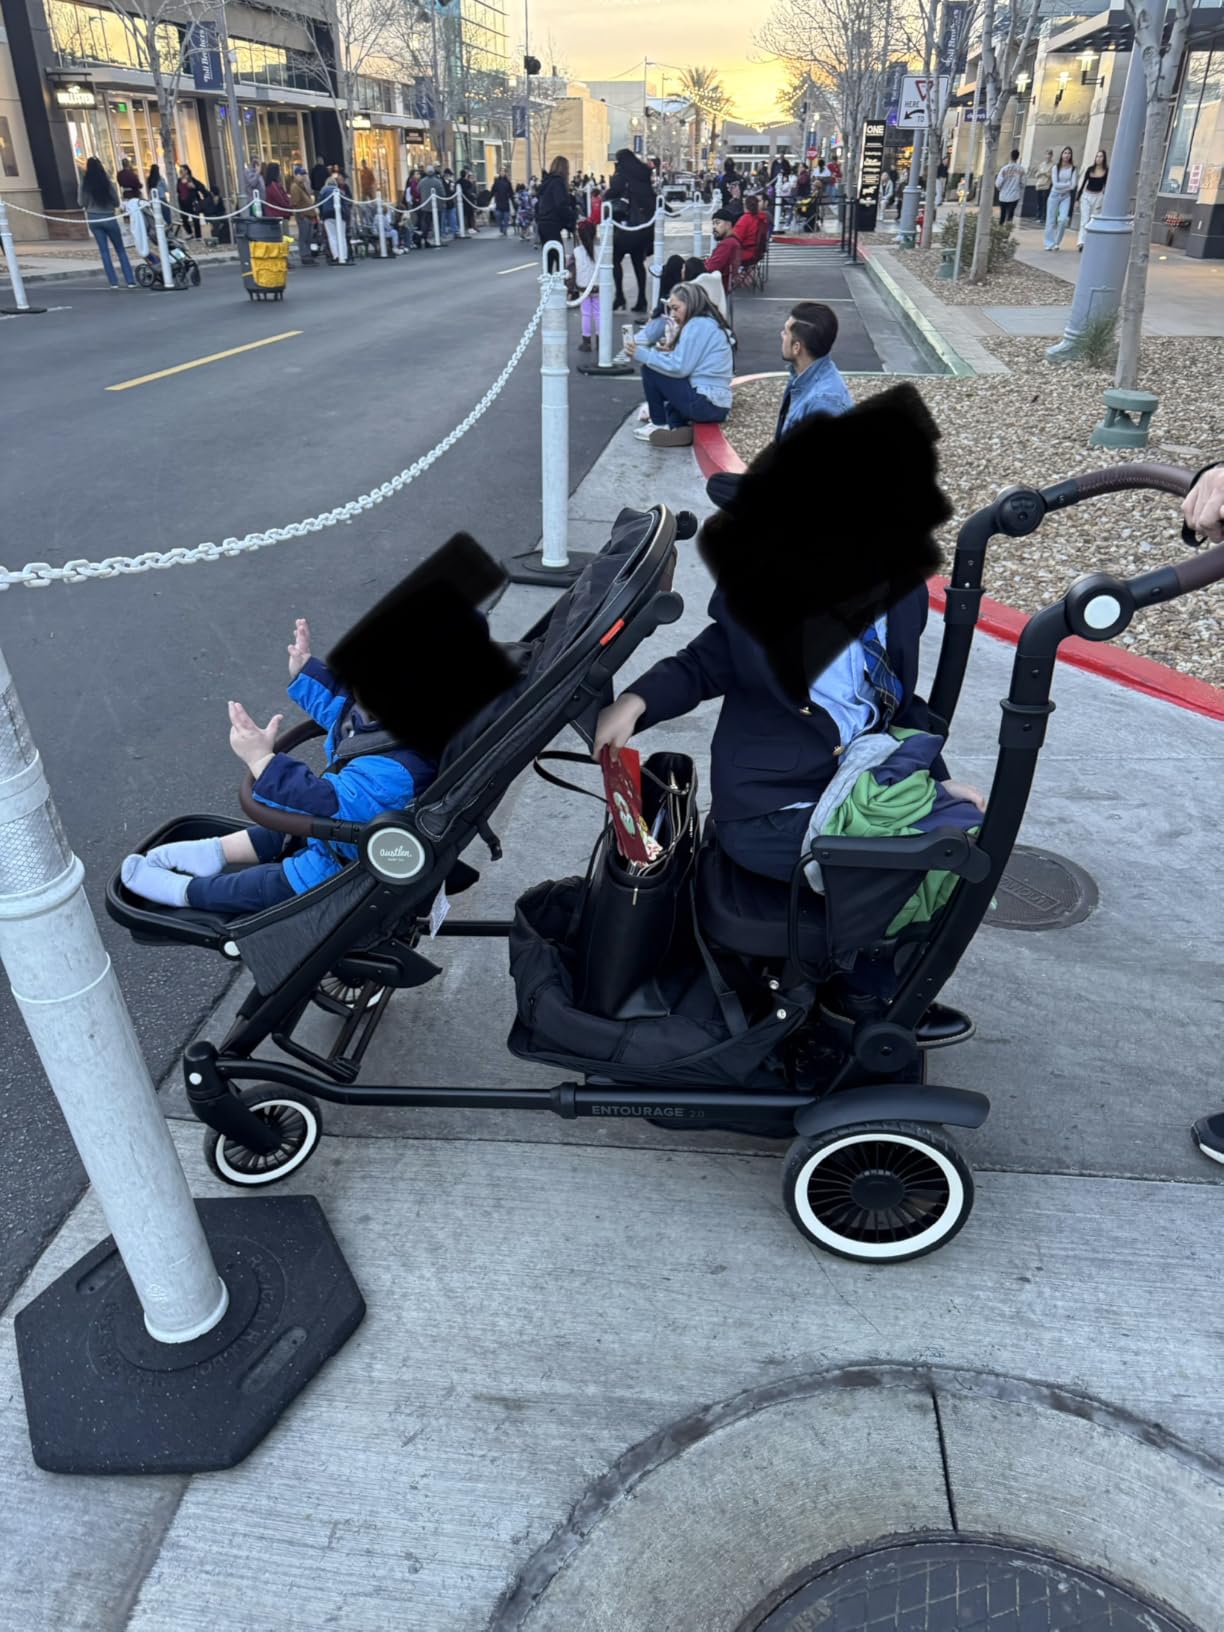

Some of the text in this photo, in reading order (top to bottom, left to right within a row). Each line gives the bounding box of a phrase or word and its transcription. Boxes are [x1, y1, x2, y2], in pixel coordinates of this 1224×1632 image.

[200, 30, 208, 65] Brohers
[904, 100, 920, 108] HERE
[866, 125, 884, 134] ONE
[591, 1105, 705, 1119] ENTOURAGE 2.0
